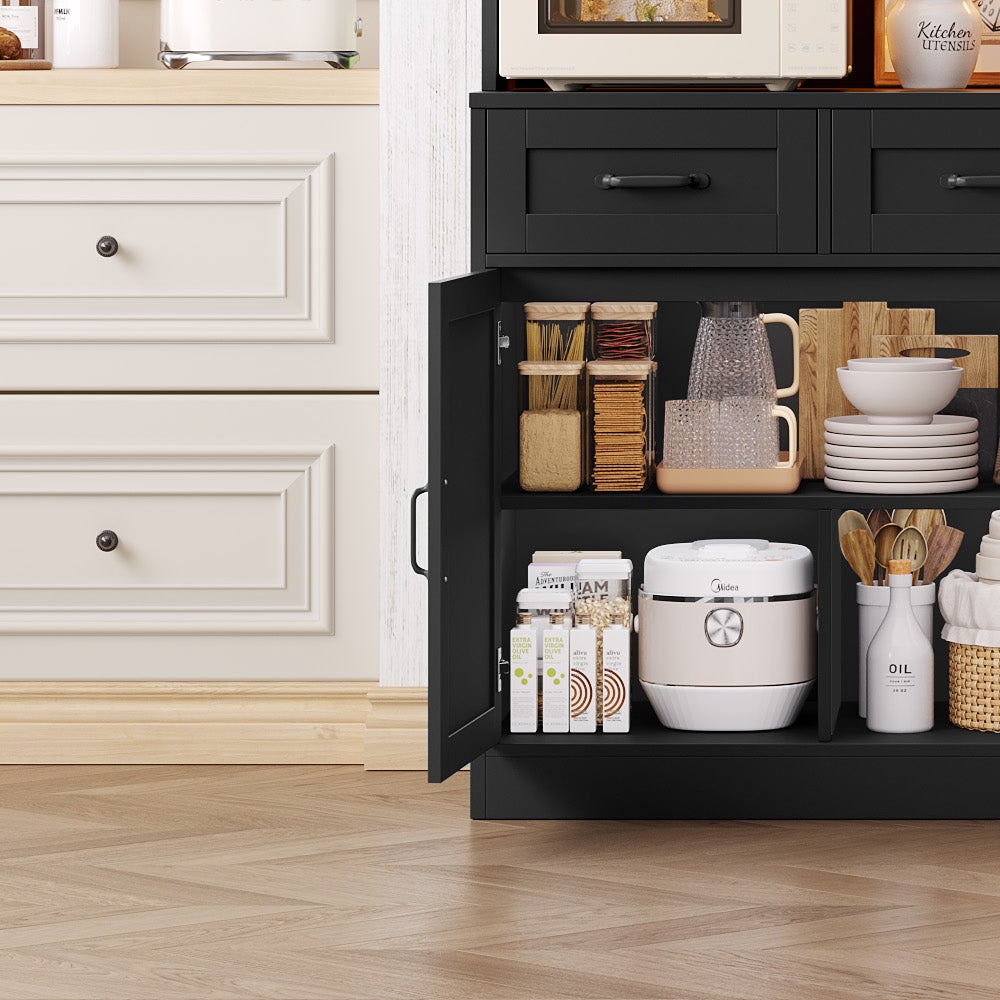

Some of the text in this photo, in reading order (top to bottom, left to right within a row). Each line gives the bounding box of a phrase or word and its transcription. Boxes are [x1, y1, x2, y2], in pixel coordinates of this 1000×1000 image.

[917, 21, 972, 39] Kitchen
[922, 39, 976, 51] UTENSILS
[711, 578, 739, 593] Midea
[889, 663, 912, 674] OIL
